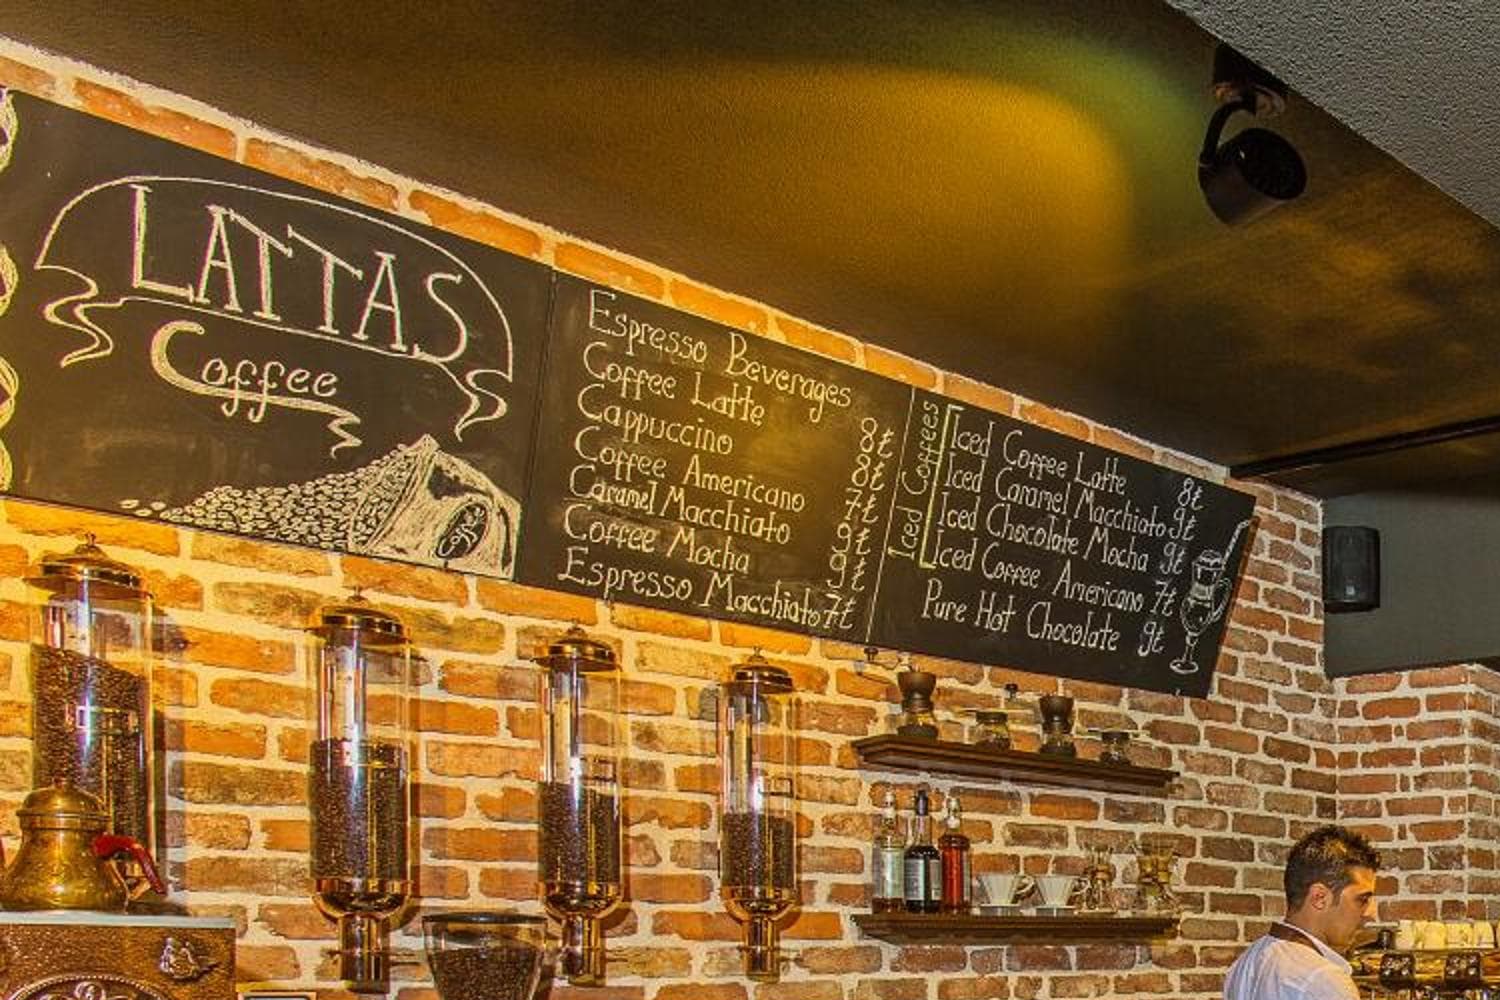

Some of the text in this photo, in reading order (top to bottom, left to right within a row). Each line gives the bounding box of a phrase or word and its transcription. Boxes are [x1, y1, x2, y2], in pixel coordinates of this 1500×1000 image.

[129, 184, 469, 364] LATTAS
[151, 320, 340, 424] Coffee
[583, 341, 677, 400] Coffee
[691, 372, 765, 426] Latte
[589, 289, 851, 423] Espresso Beverages
[577, 383, 734, 455] Cappuccino
[951, 414, 995, 458] Iced
[1003, 430, 1068, 481] Coffee
[1074, 451, 1127, 495] Latte
[569, 464, 658, 515] Caramel
[660, 485, 791, 545] Macchiato
[575, 426, 667, 482] Coffee
[683, 453, 805, 512] Americano
[887, 400, 942, 561] Iced Coffees
[944, 452, 987, 493] Iced
[995, 467, 1071, 515] Caramel
[1074, 488, 1167, 537] Macchiato
[564, 503, 661, 553] Coffee
[666, 525, 751, 574] Mocha
[932, 529, 979, 572] Iced
[981, 541, 1041, 588] Coffee
[1052, 559, 1144, 613] Americano
[937, 491, 981, 531] Iced
[986, 503, 1079, 555] Chocolate
[1083, 526, 1149, 572] Mocha
[558, 545, 693, 600] Espresso
[698, 571, 821, 626] Macchiato
[921, 577, 967, 623] Pure
[974, 589, 1017, 633] Hot
[1027, 601, 1121, 651] Chocolate
